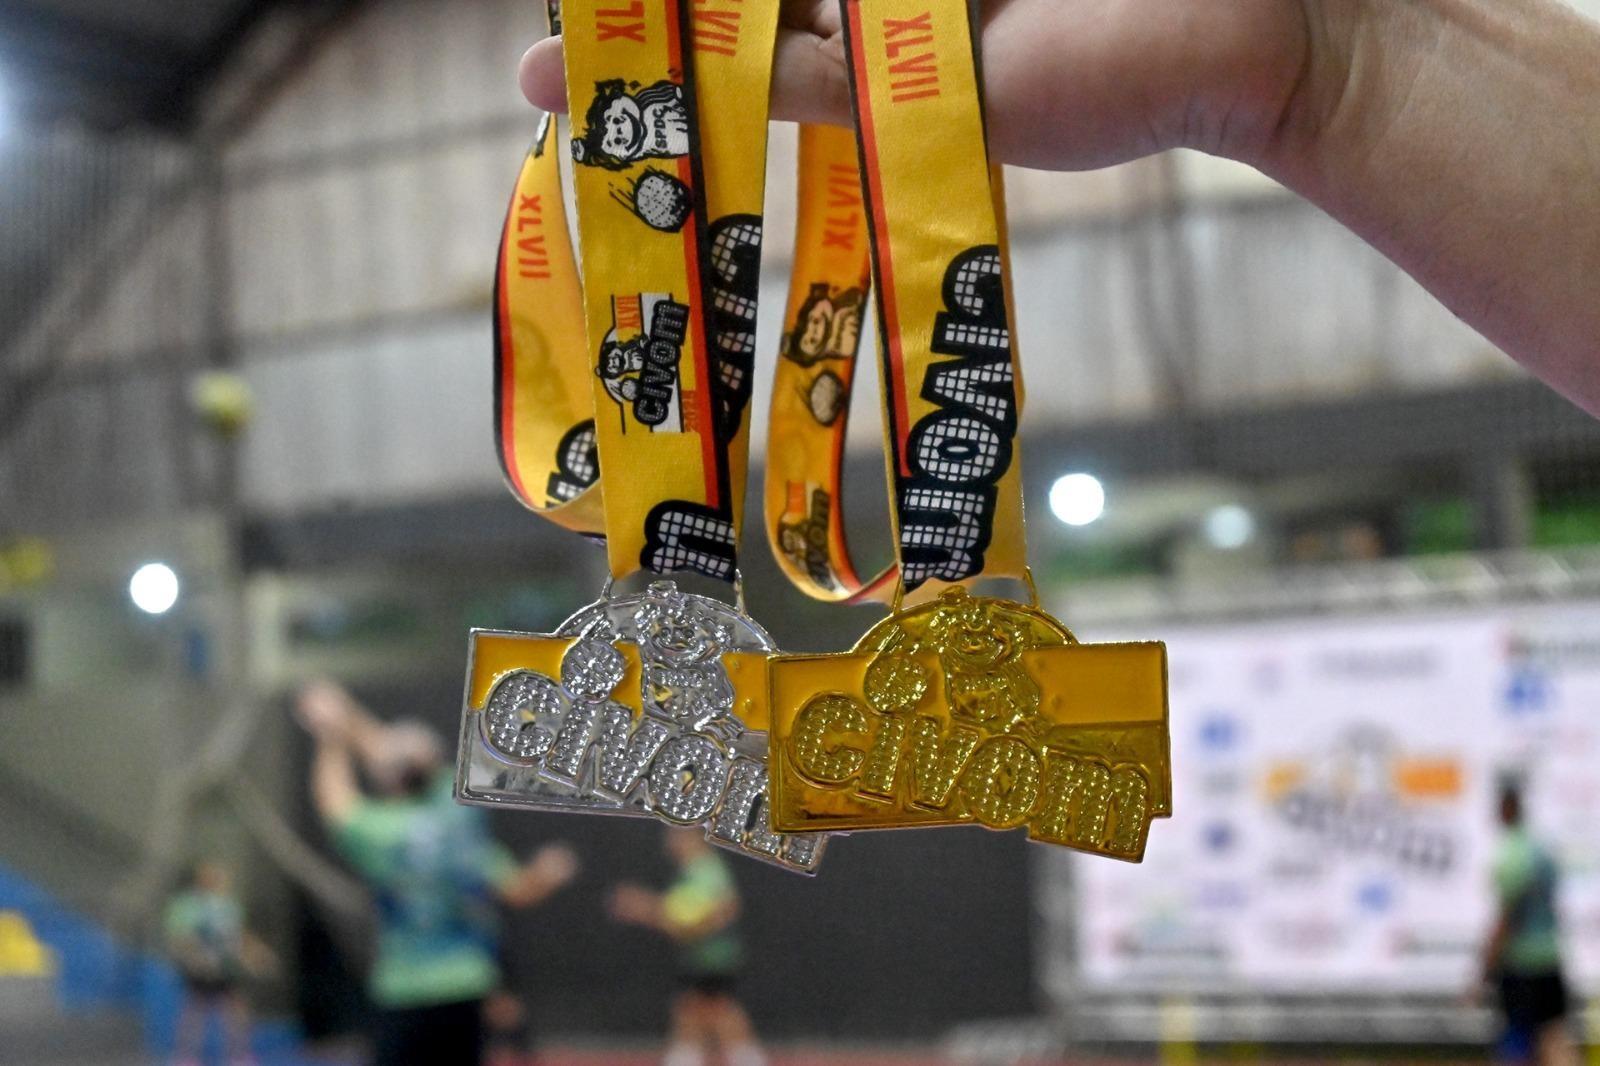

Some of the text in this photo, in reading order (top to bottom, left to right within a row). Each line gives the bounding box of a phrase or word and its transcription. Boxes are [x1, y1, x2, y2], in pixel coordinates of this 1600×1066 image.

[882, 10, 940, 104] XLVII
[652, 108, 668, 149] SPDC
[516, 192, 551, 280] XLVII
[822, 163, 861, 250] XLVII
